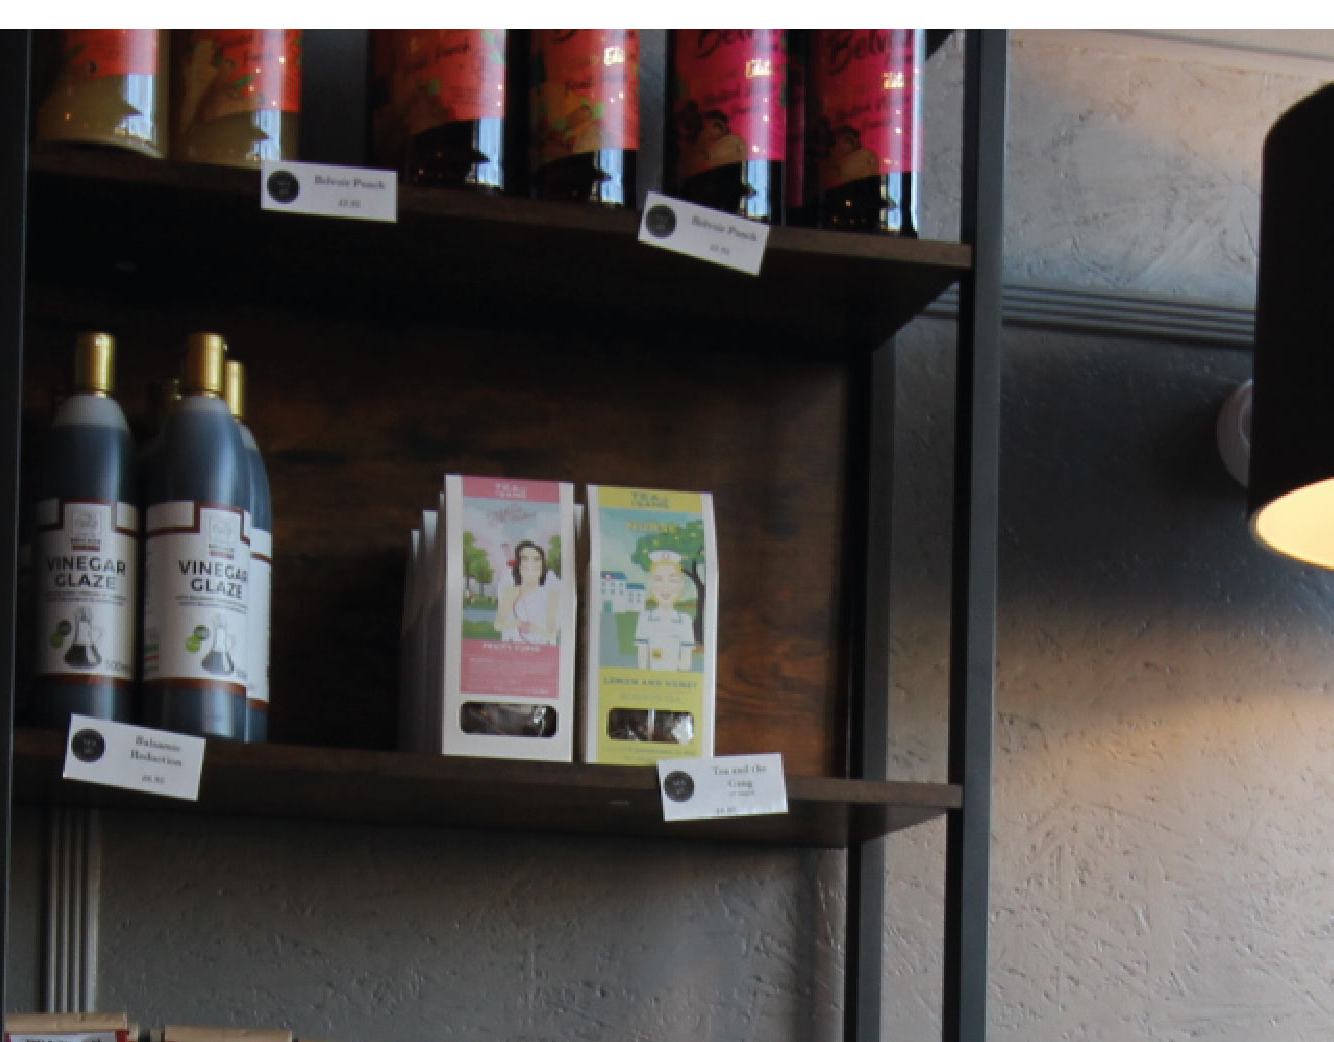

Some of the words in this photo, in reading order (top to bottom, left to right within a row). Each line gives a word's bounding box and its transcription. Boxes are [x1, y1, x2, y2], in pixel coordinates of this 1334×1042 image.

[47, 556, 126, 575] VINEGAR
[54, 573, 116, 590] GLAZE
[190, 578, 243, 600] GLAZE
